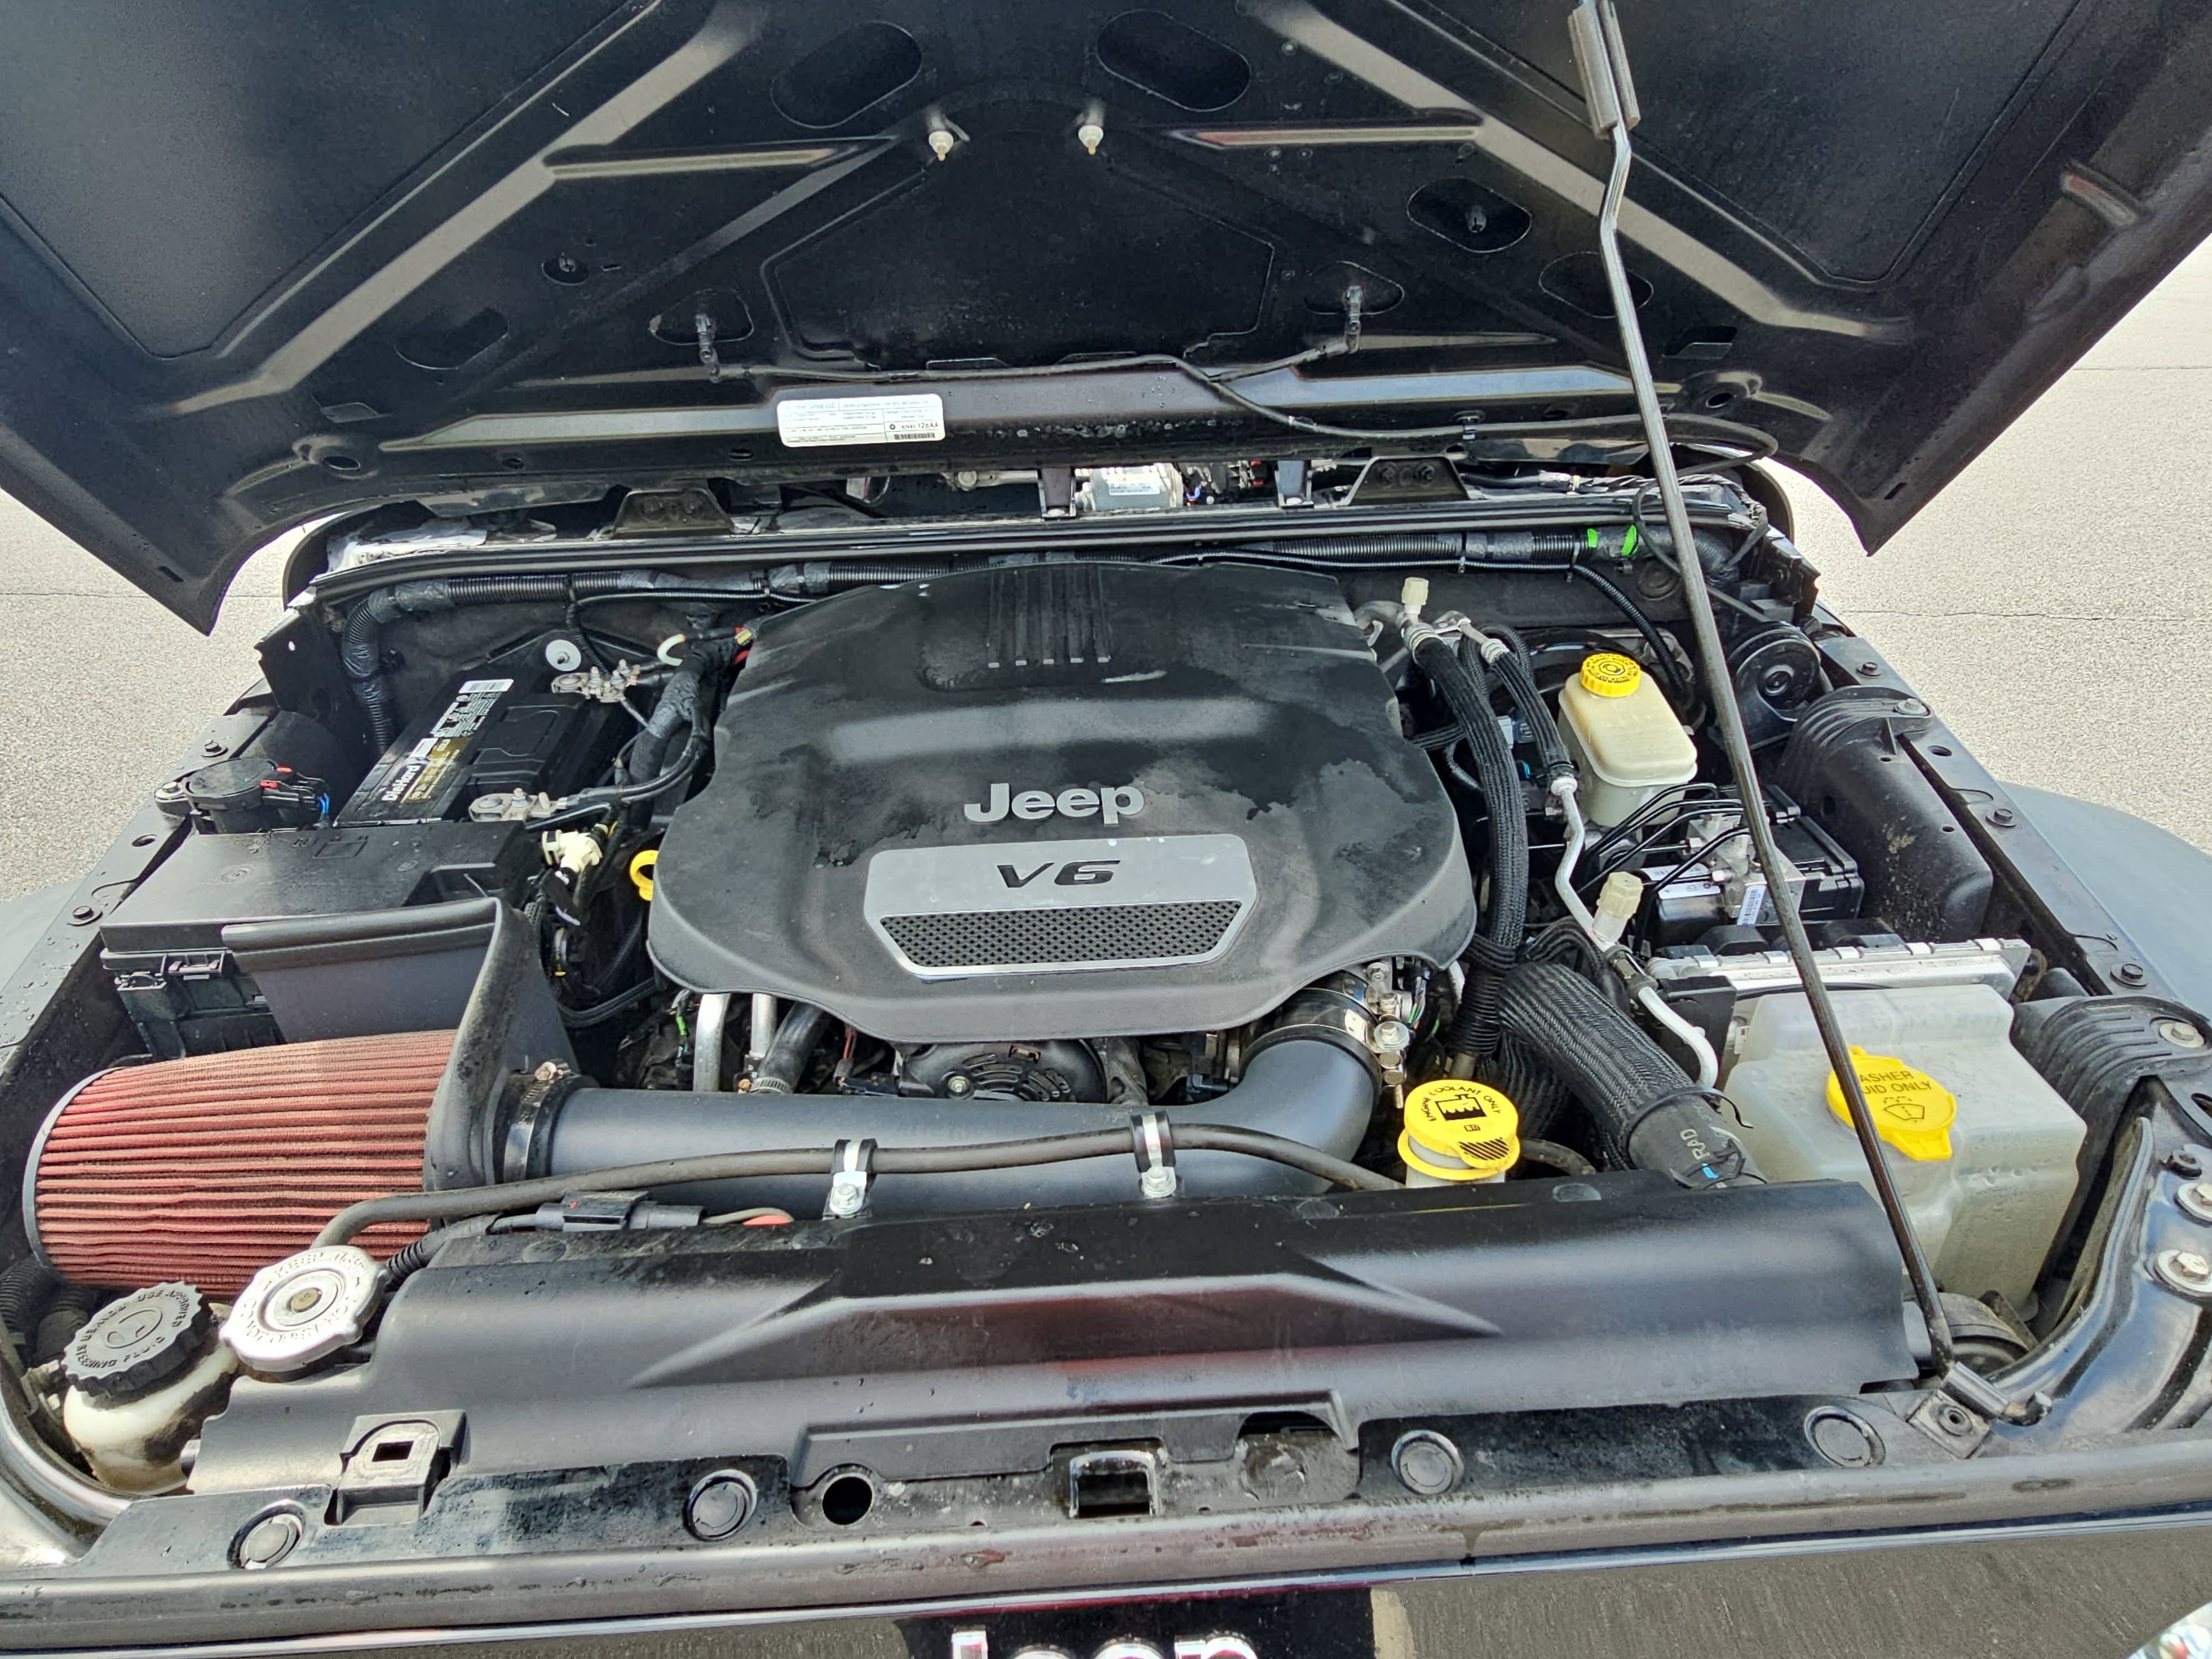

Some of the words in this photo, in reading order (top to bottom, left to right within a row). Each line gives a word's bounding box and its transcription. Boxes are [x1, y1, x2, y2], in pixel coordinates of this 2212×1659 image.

[382, 765, 421, 801] DieHard
[964, 783, 1145, 826] Jeep
[997, 860, 1121, 889] V6
[1859, 1071, 1914, 1082] ASHER
[1861, 1084, 1887, 1094] UID
[1892, 1081, 1932, 1092] ONLY
[1429, 1086, 1482, 1096] COOLANT
[1484, 1095, 1501, 1114] ONLY
[137, 1289, 164, 1302] USE
[123, 1336, 166, 1363] FLUID
